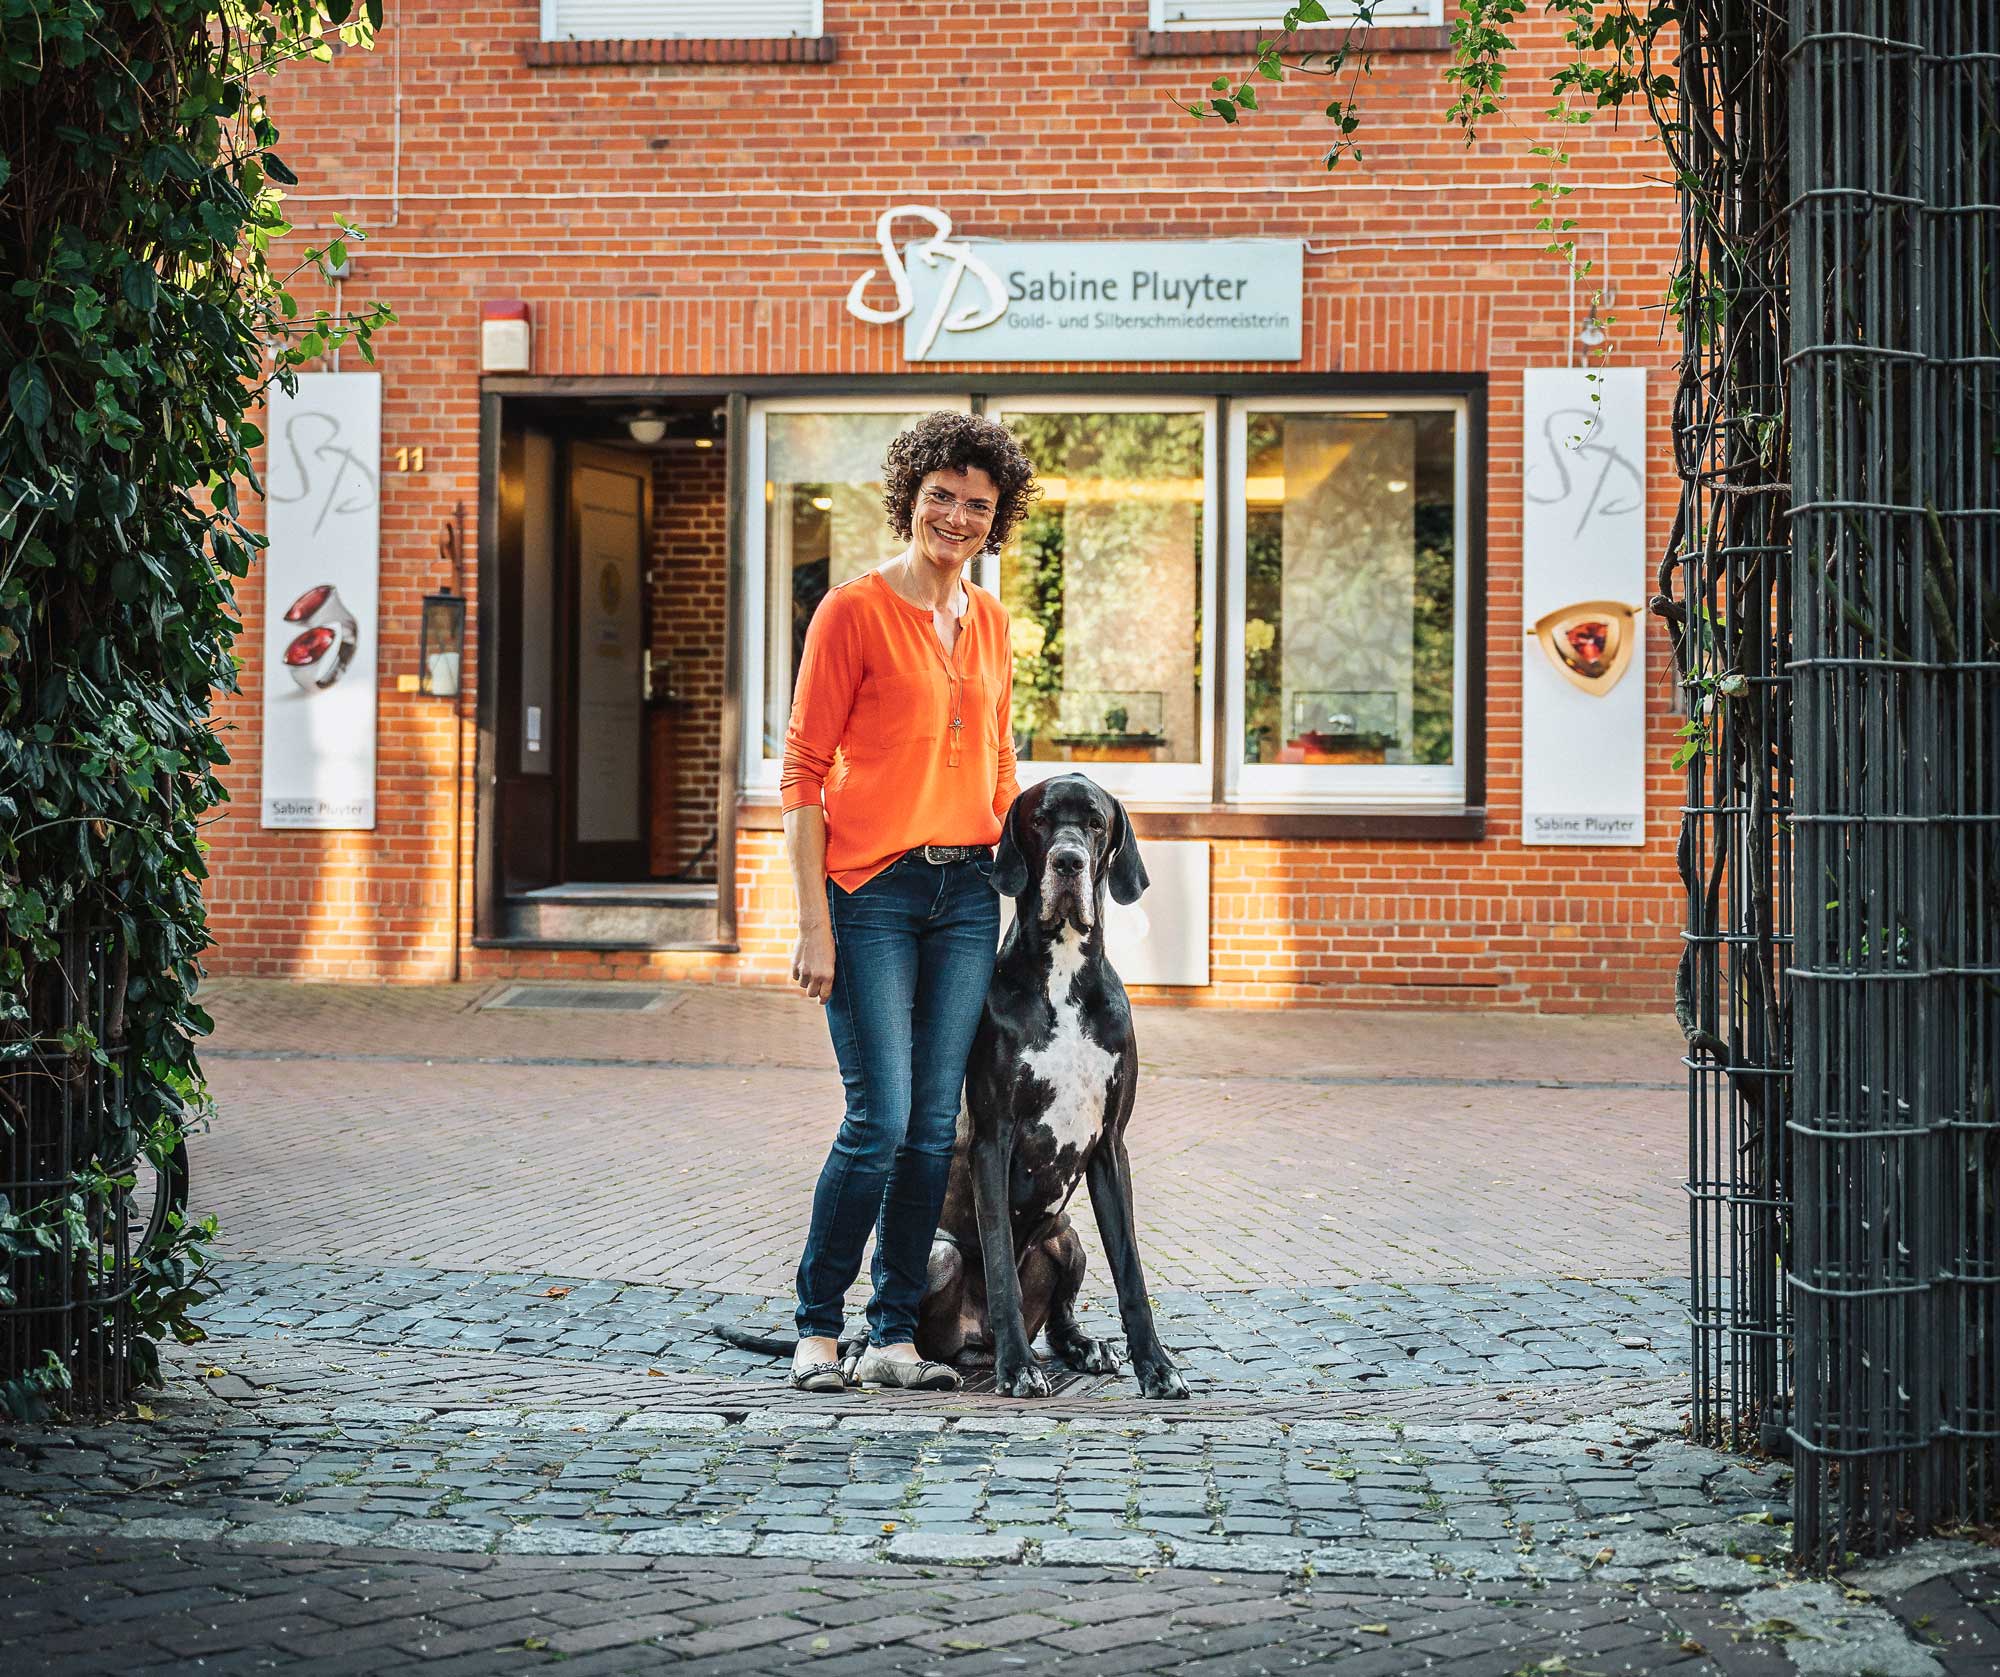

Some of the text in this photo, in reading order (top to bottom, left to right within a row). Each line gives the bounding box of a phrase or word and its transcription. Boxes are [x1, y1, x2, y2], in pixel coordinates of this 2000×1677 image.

[1008, 271, 1248, 310] Sabine Pluyter
[1008, 312, 1290, 328] Gold- und Silberschmiedemeisterin
[394, 447, 424, 471] 11
[272, 801, 314, 815] Sabine
[1535, 817, 1634, 833] Sabine Pluyter
